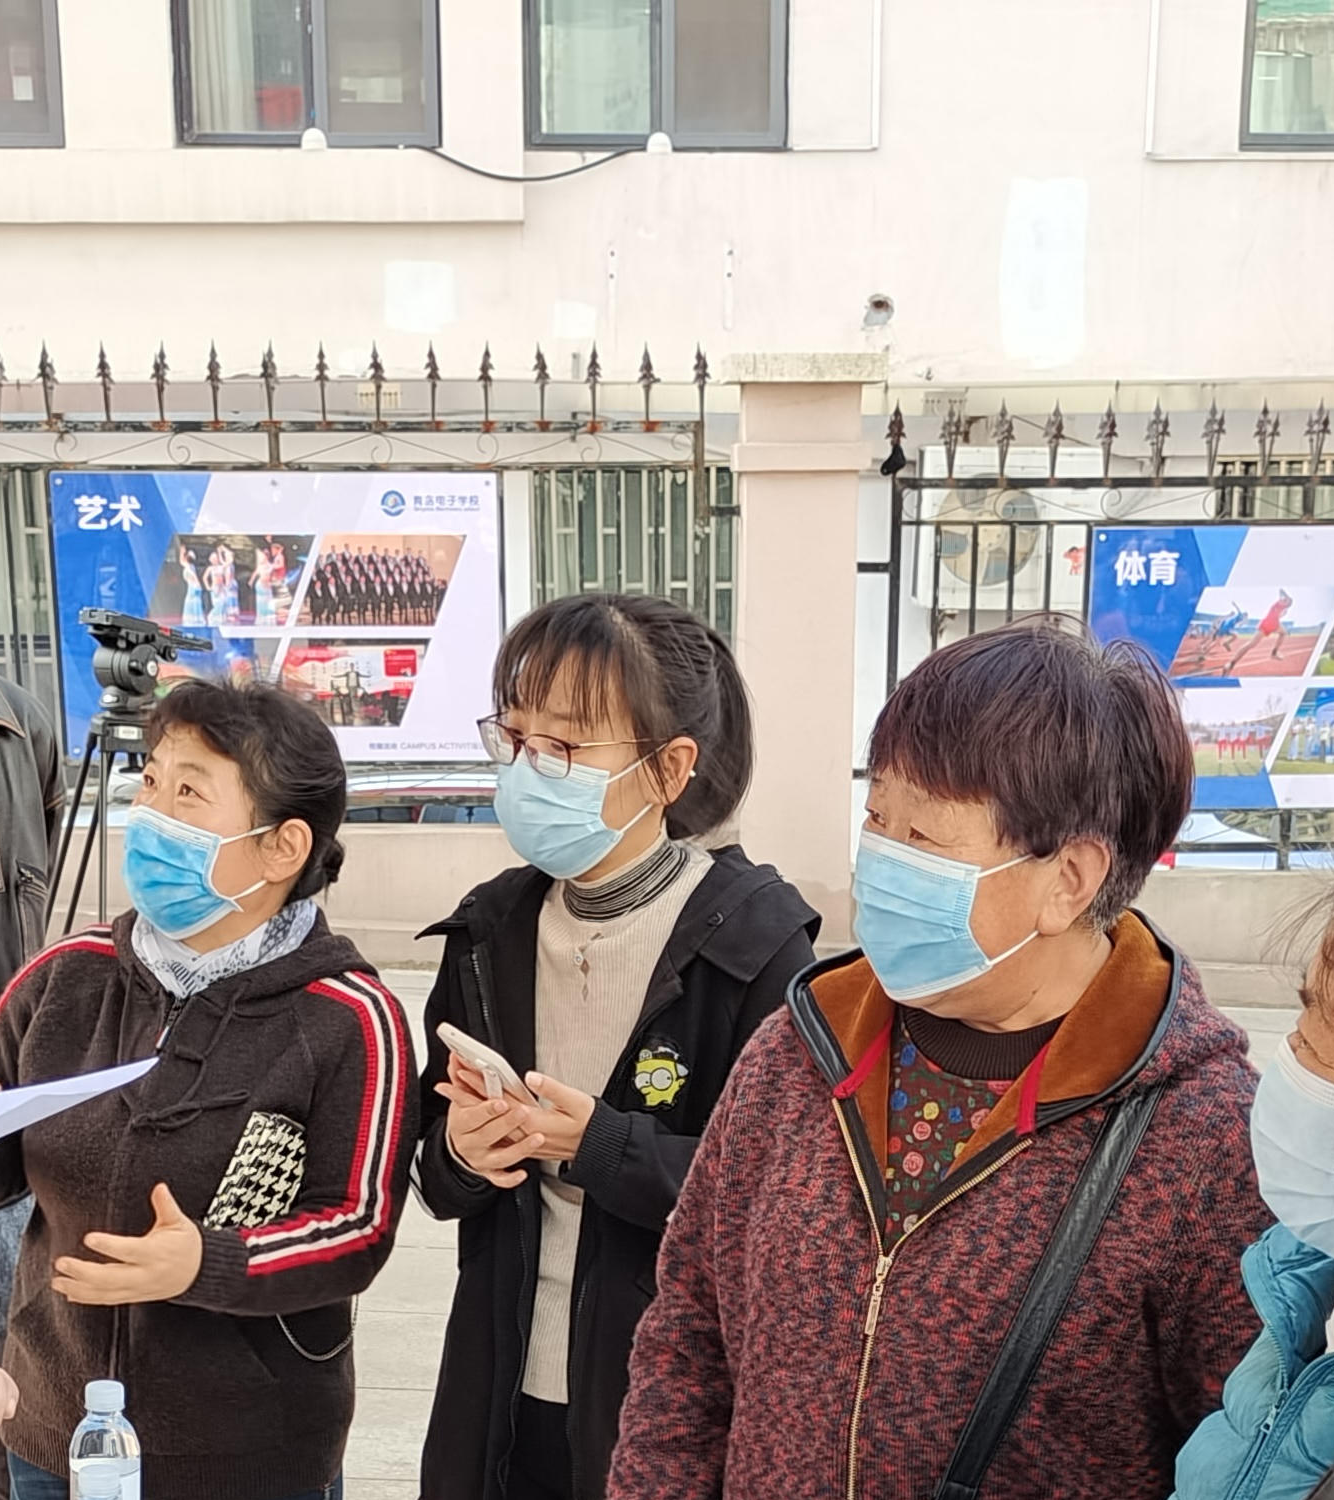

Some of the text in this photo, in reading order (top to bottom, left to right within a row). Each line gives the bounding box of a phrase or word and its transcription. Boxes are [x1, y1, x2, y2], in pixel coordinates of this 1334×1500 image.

[74, 496, 144, 532] 艺术
[1114, 551, 1180, 586] 体育
[400, 743, 436, 751] CAMPUS
